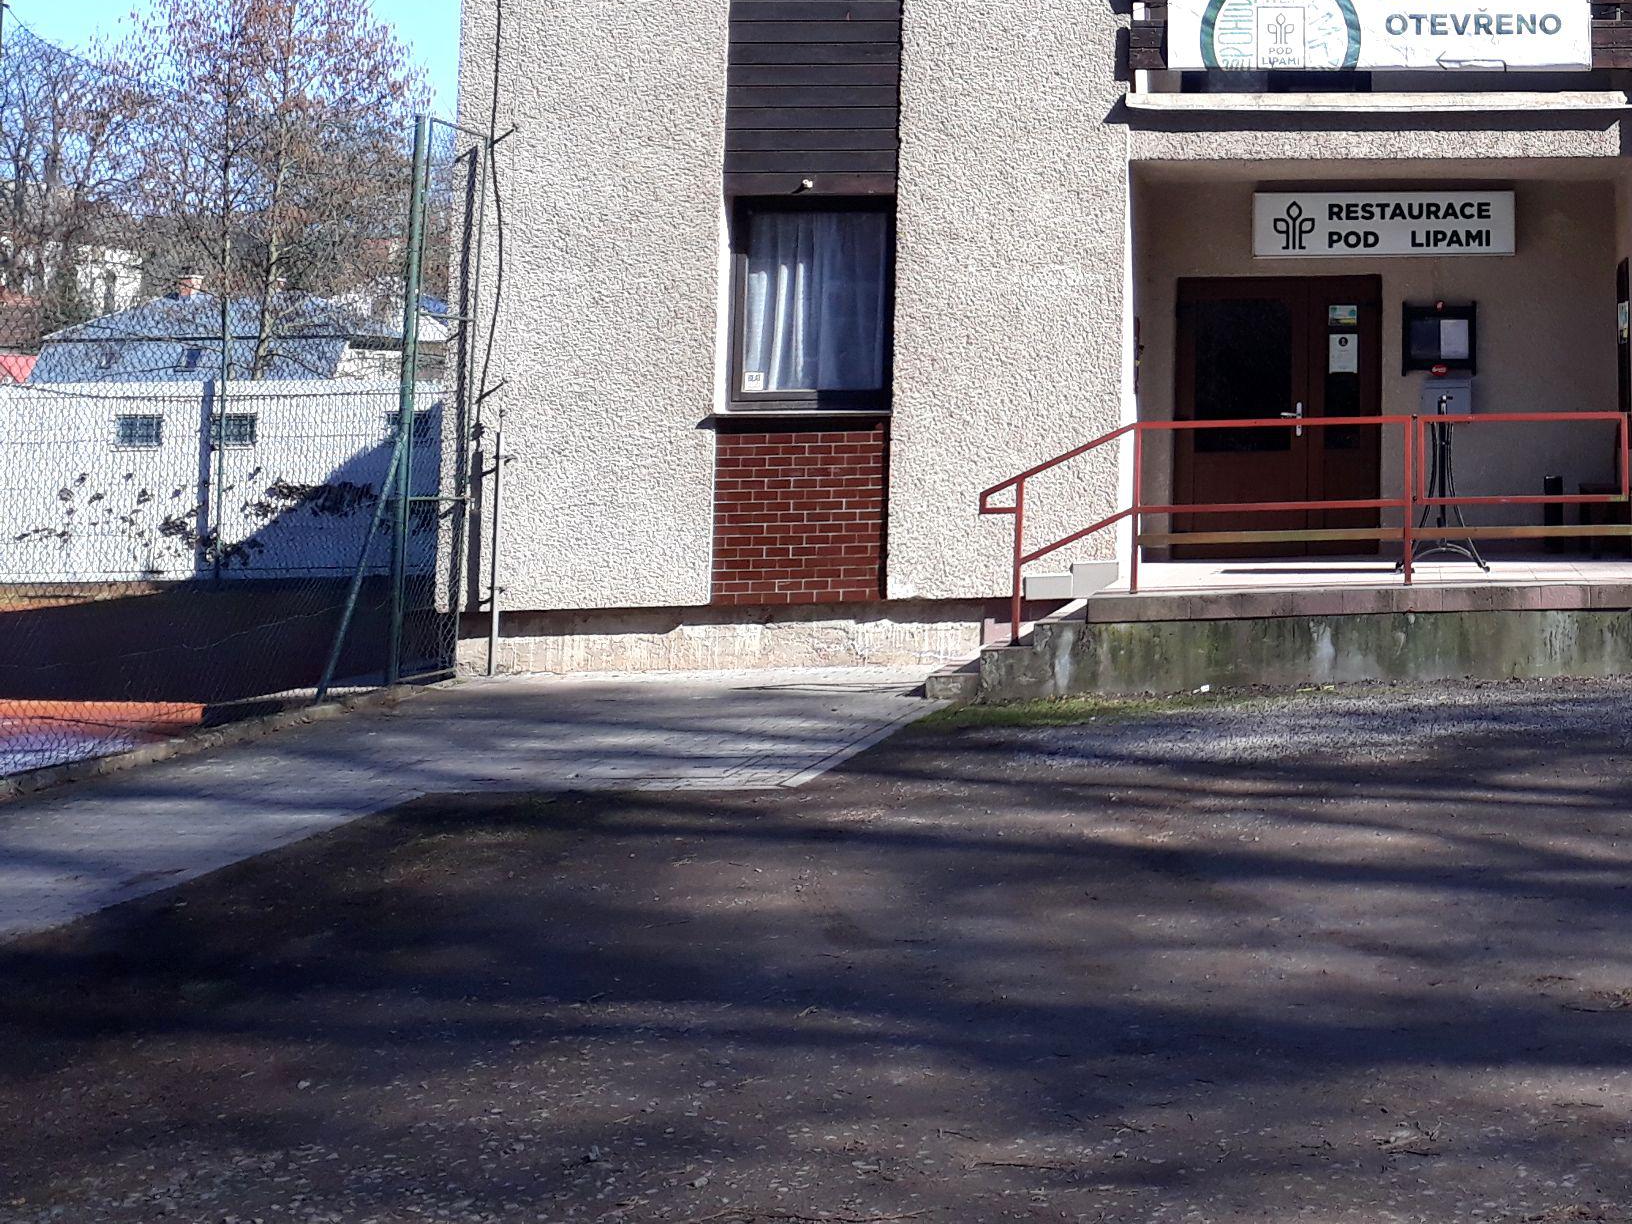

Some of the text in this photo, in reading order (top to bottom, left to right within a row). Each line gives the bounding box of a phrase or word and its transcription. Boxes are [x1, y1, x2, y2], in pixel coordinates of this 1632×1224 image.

[1385, 8, 1562, 36] OTEVŘENO
[1268, 47, 1293, 55] POD
[1262, 56, 1300, 66] LIPAMI
[1327, 202, 1492, 221] RESTAURACE
[1327, 229, 1491, 249] POD LIPAMI
